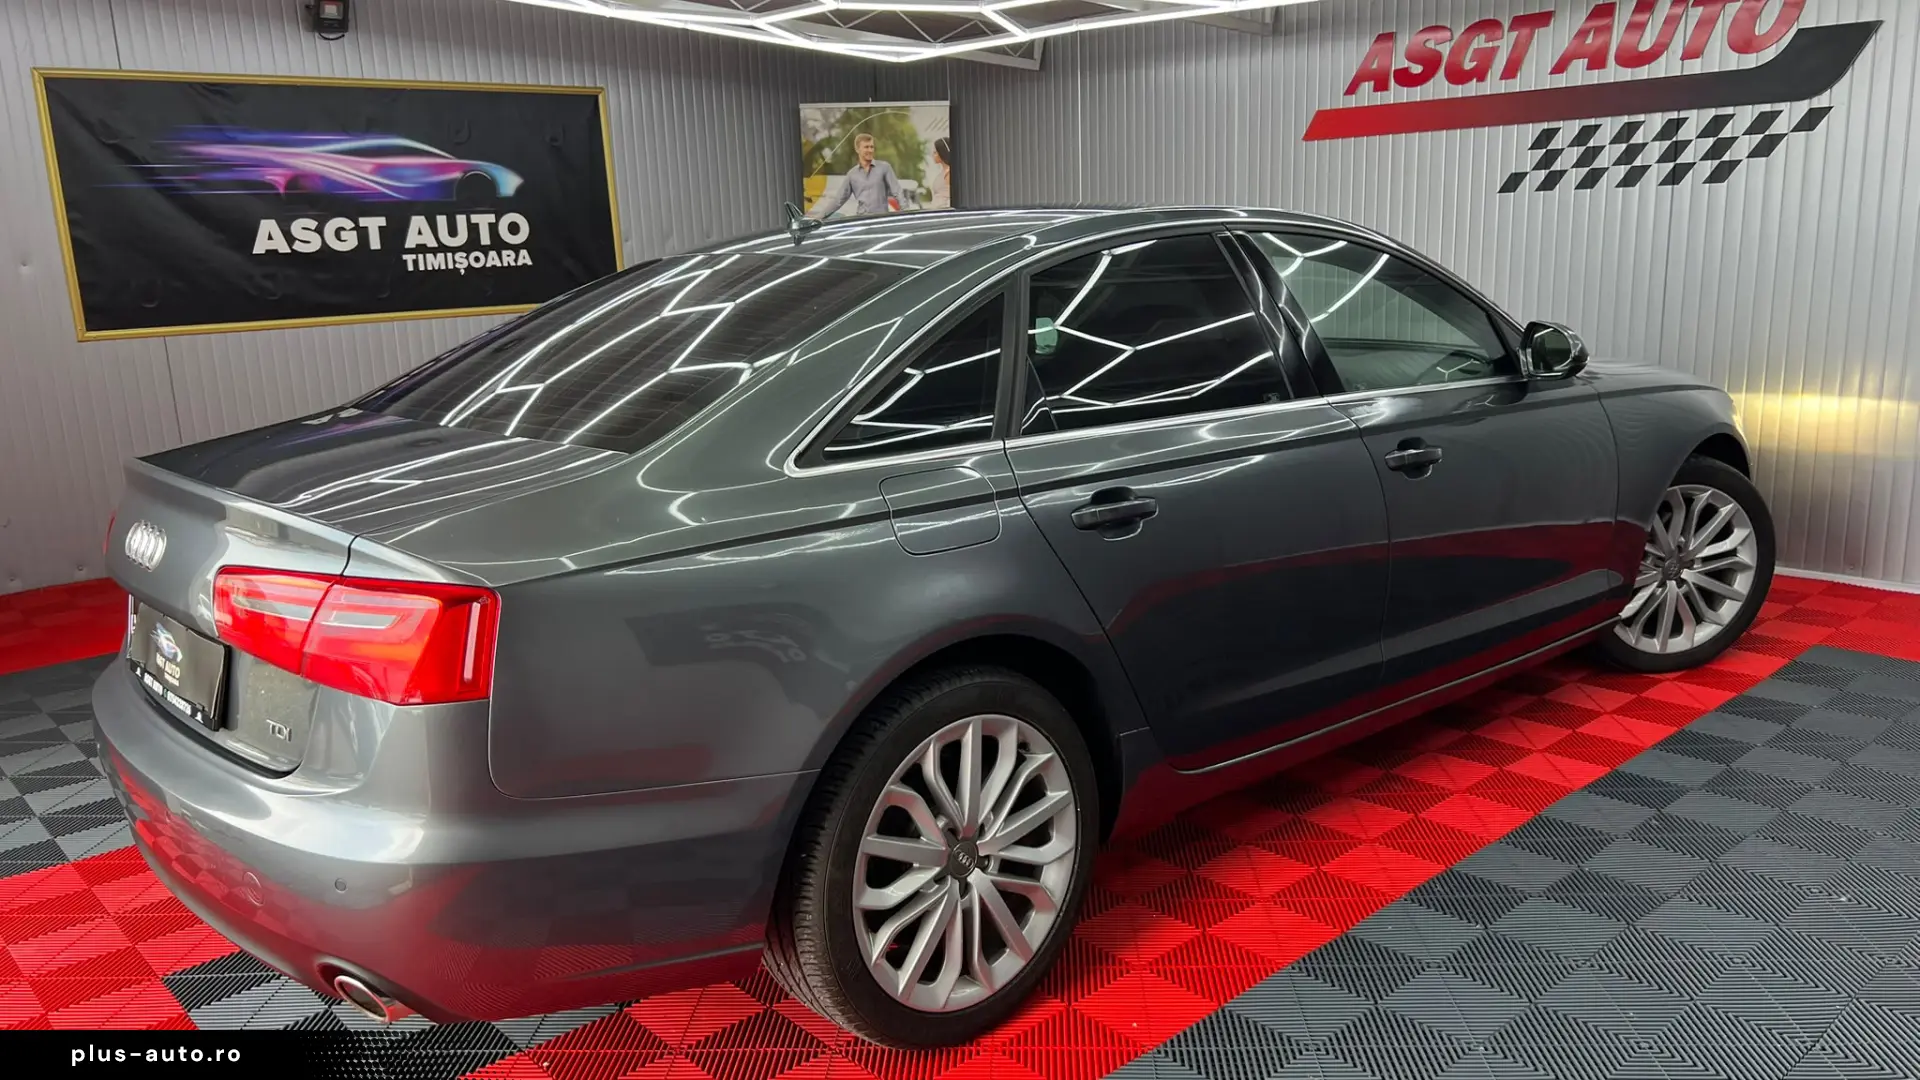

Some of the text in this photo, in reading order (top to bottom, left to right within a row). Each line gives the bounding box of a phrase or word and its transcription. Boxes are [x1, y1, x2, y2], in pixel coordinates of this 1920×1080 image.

[1344, 0, 1803, 96] ASGT AUTO
[252, 212, 530, 254] ASGT AUTO
[402, 249, 533, 275] TIMIȘOARA
[265, 718, 292, 743] TDI
